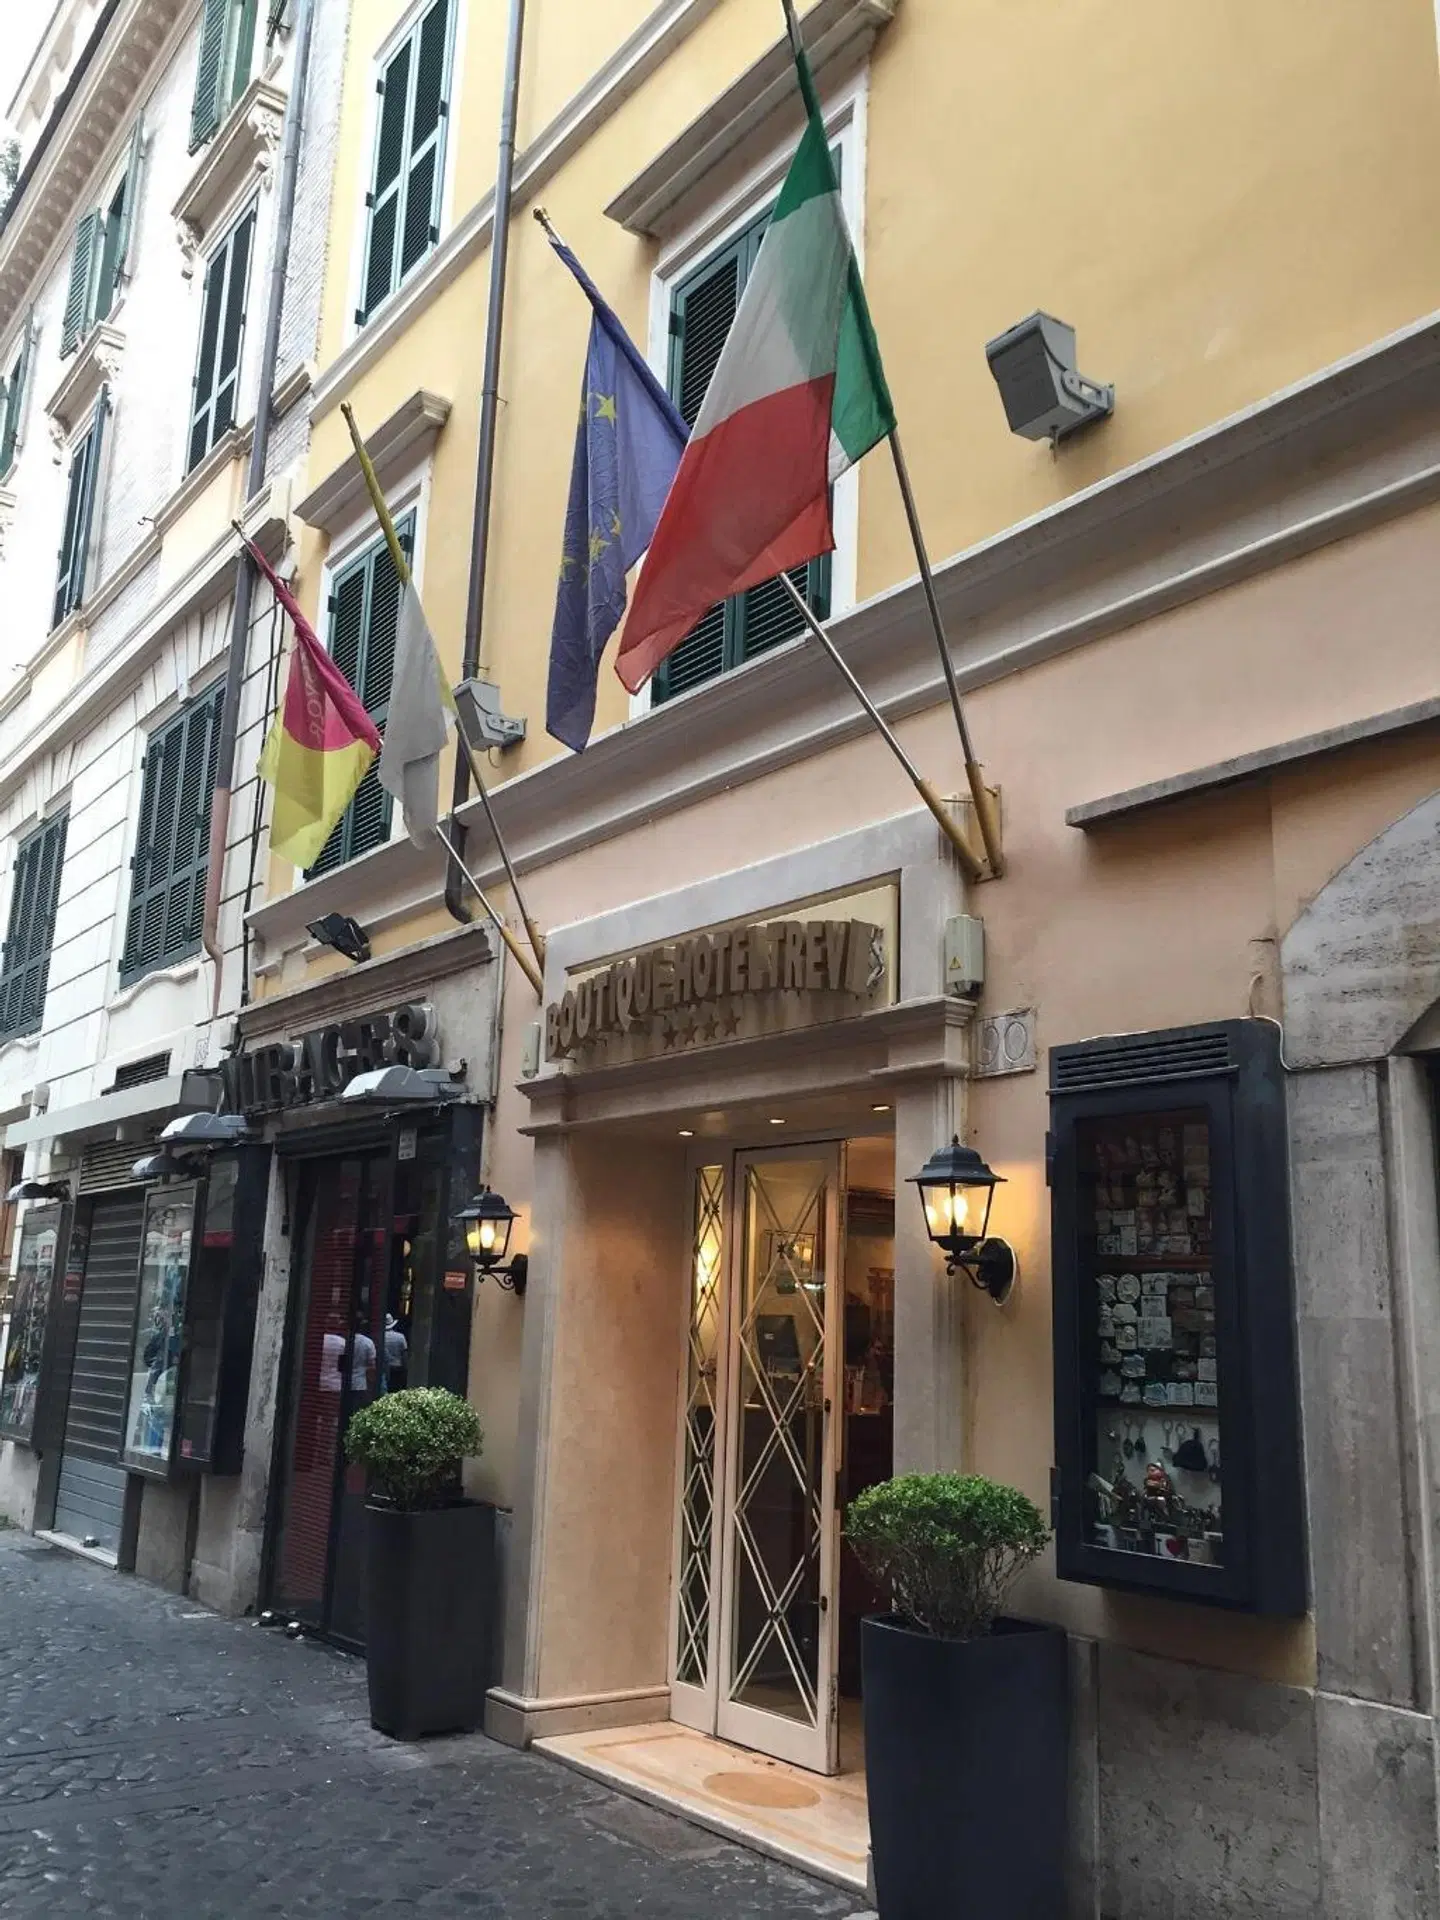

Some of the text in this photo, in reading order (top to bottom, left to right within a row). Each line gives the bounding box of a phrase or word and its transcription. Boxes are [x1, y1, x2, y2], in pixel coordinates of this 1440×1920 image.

[545, 917, 884, 1062] BOUTIQUE HOTEL TREVI
